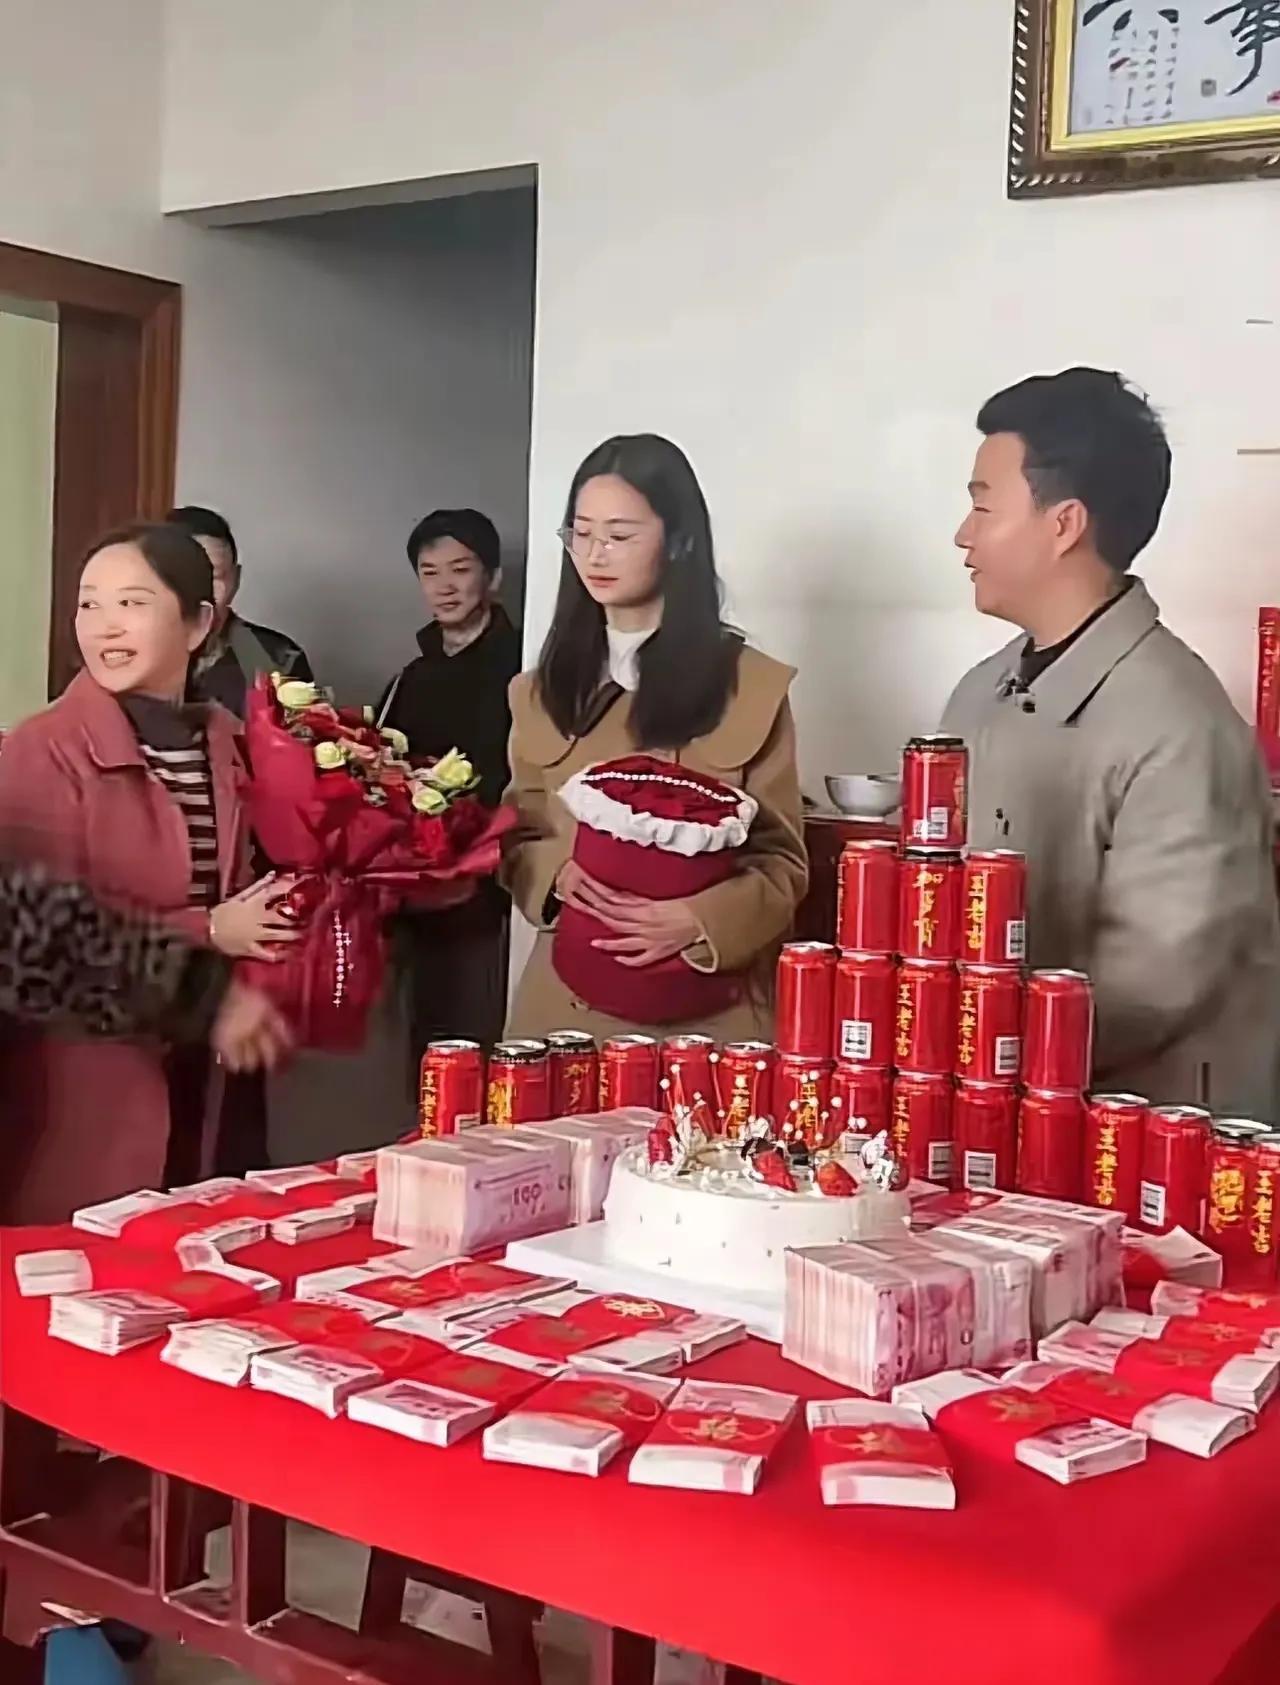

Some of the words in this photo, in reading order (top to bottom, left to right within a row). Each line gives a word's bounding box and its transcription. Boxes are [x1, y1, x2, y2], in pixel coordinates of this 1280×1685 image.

[895, 983, 916, 1057] 王老吉
[957, 990, 977, 1066] 王老吉
[1094, 1126, 1118, 1206] 王老吉
[1250, 1169, 1274, 1254] 王老吉
